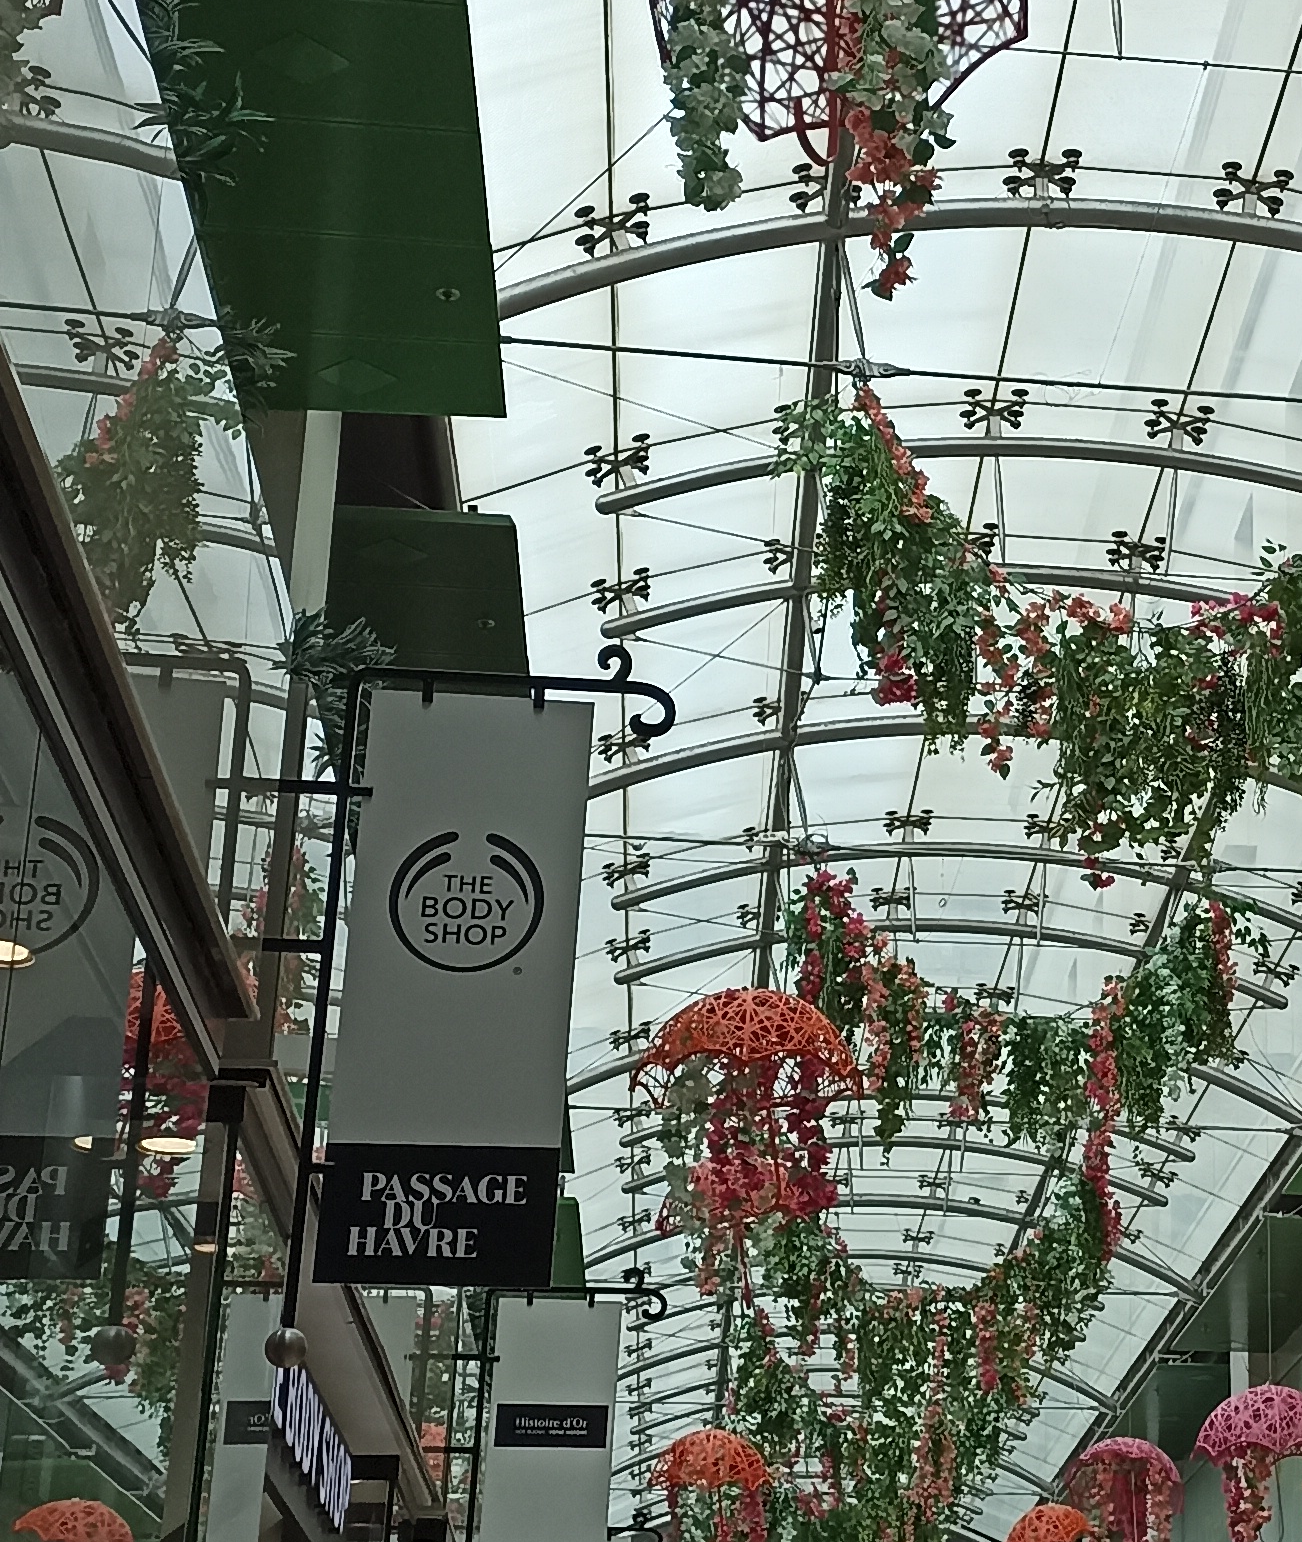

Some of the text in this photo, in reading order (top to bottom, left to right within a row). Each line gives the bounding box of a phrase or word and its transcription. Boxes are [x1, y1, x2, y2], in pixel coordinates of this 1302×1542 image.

[443, 874, 493, 894] THE
[421, 896, 514, 921] BODY
[424, 923, 507, 945] SHOP
[361, 1172, 527, 1205] PASSAGE
[383, 1199, 437, 1230] DU
[347, 1227, 478, 1257] HAVRE
[515, 1417, 588, 1428] Histoire d'Or
[286, 1365, 352, 1535] BODY SHOP
